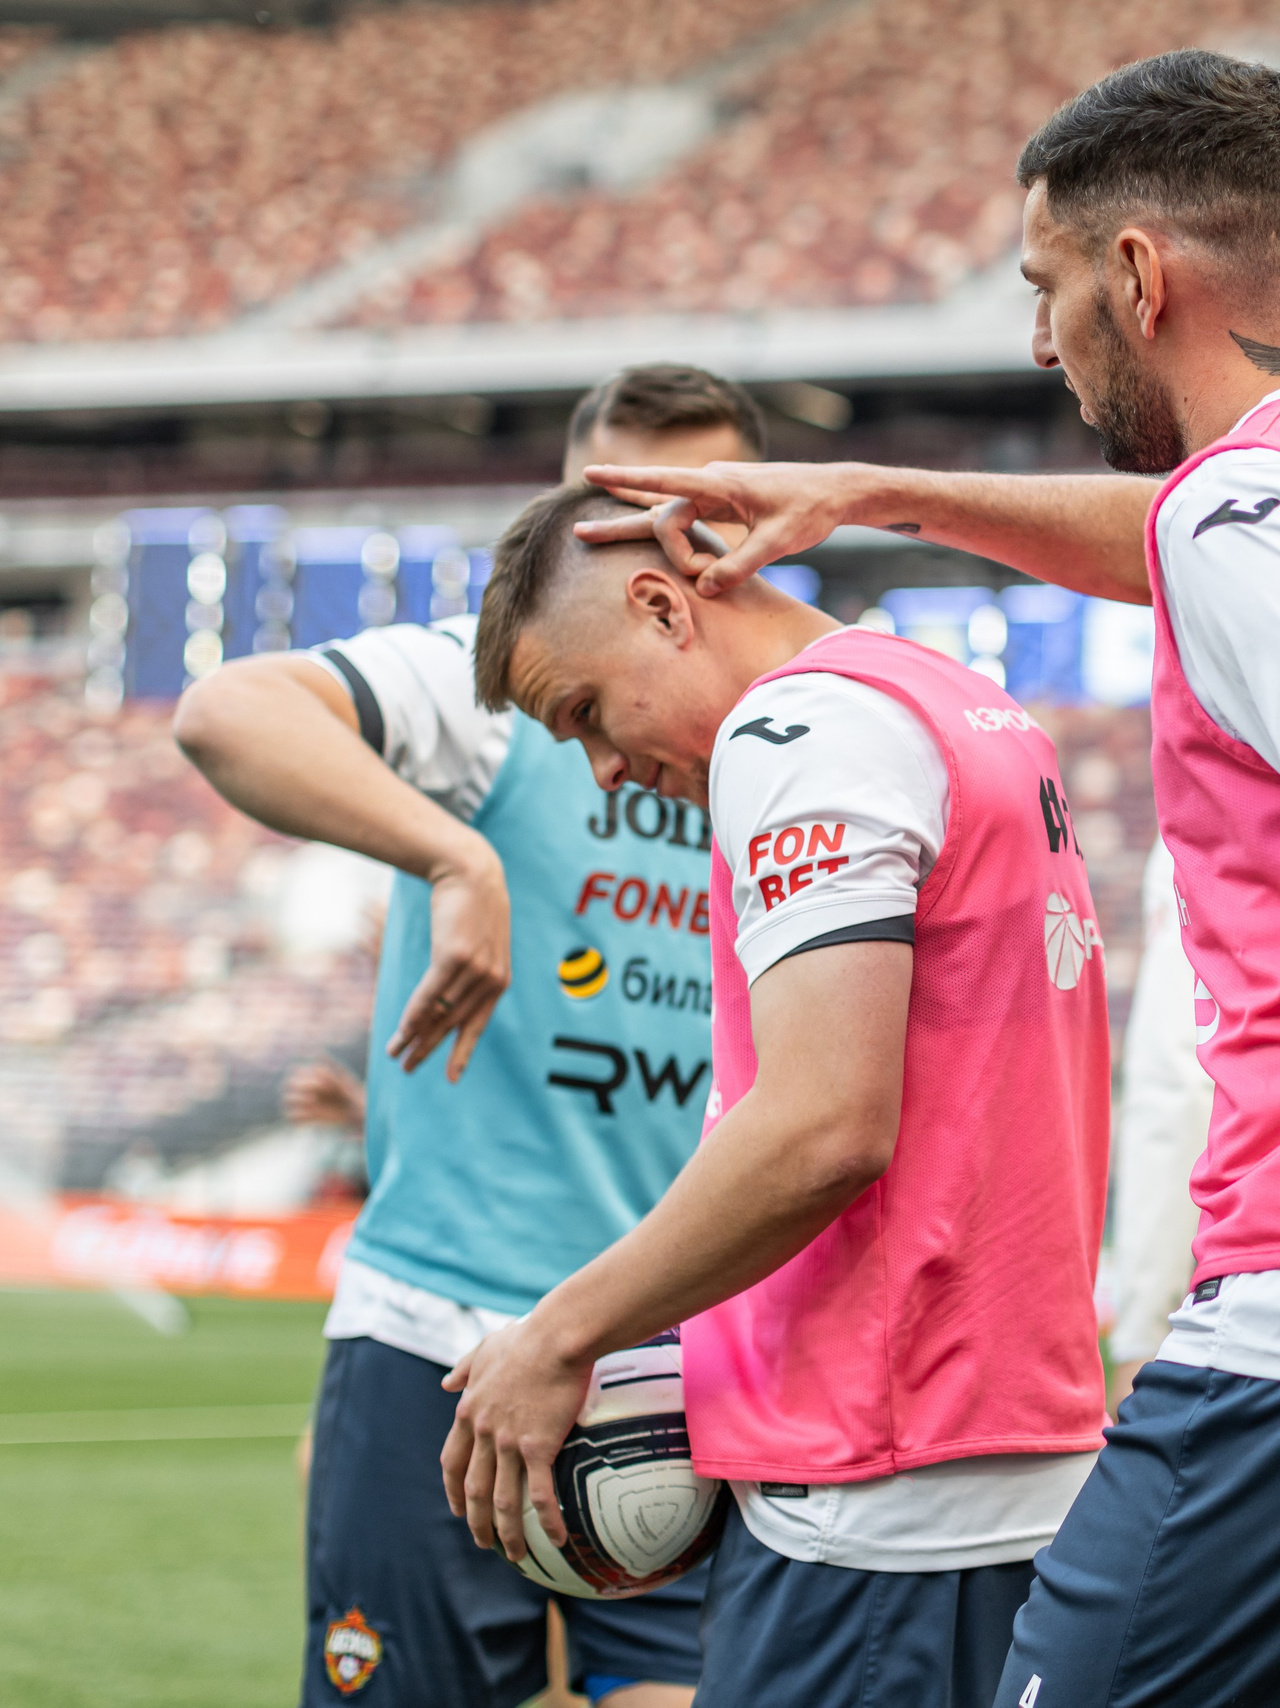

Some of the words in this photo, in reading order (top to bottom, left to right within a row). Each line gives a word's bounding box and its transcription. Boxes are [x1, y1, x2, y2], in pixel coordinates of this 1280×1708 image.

[748, 823, 846, 876] FON
[574, 870, 711, 936] FONB
[547, 1035, 709, 1117] RW
